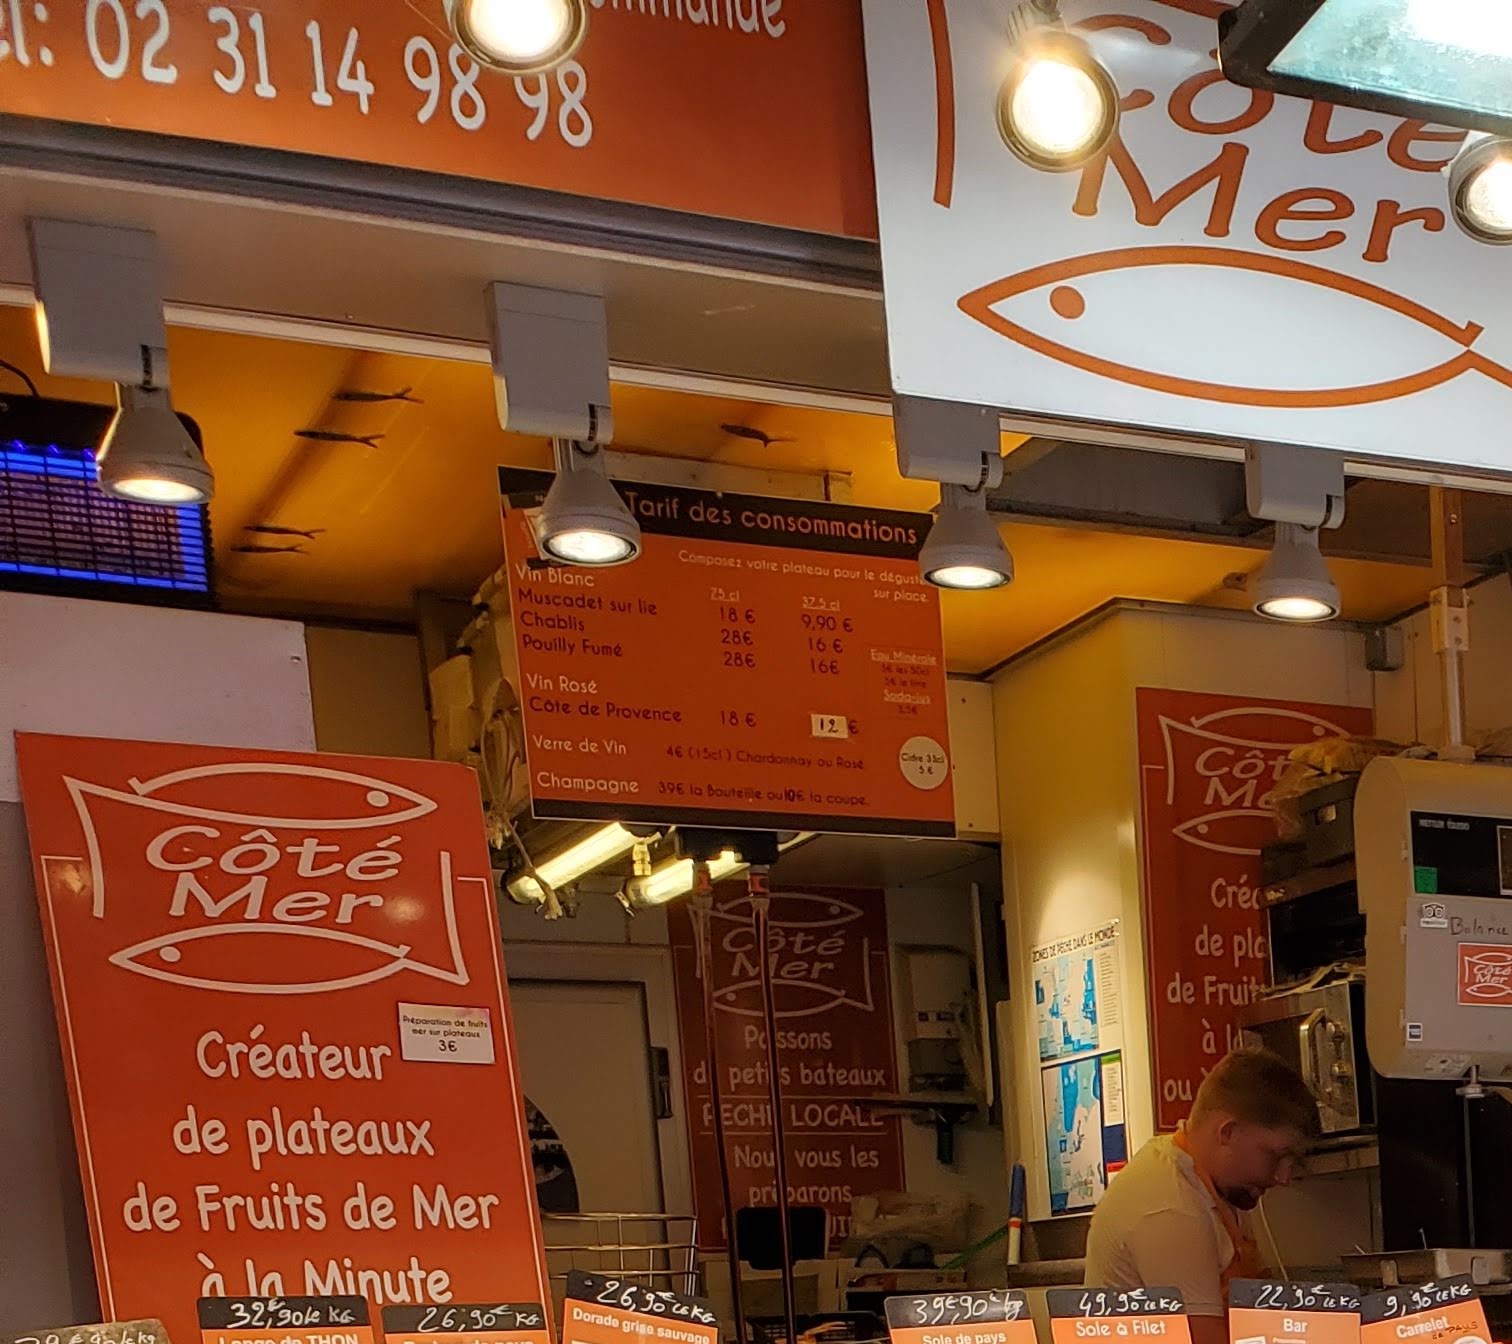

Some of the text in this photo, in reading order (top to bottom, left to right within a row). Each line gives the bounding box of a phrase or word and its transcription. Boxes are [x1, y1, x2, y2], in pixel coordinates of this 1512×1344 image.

[86, 0, 178, 84] 02
[208, 7, 277, 98] 31
[306, 20, 374, 114] 14
[404, 36, 486, 130] 98
[1072, 142, 1445, 262] Mer
[624, 491, 918, 545] Tarif des consommations
[782, 561, 830, 578] plateau
[894, 588, 928, 603] place
[520, 610, 584, 632] Chablis
[522, 633, 623, 657] Pouilly Fumé
[526, 672, 599, 694] Vin Rosé
[529, 695, 682, 723] Côte de Provence
[533, 734, 626, 756] Verre de Vin
[537, 771, 640, 795] Champagne
[146, 823, 403, 881] Côté
[169, 871, 385, 924] Mer
[196, 1024, 392, 1081] Créateur
[800, 1062, 886, 1087] bateaux
[173, 1104, 435, 1170] de plateaux
[123, 1181, 499, 1232] de Fruits de Mer
[572, 1307, 620, 1330] Dorade
[621, 1318, 654, 1337] grise
[1282, 1317, 1308, 1333] Bar
